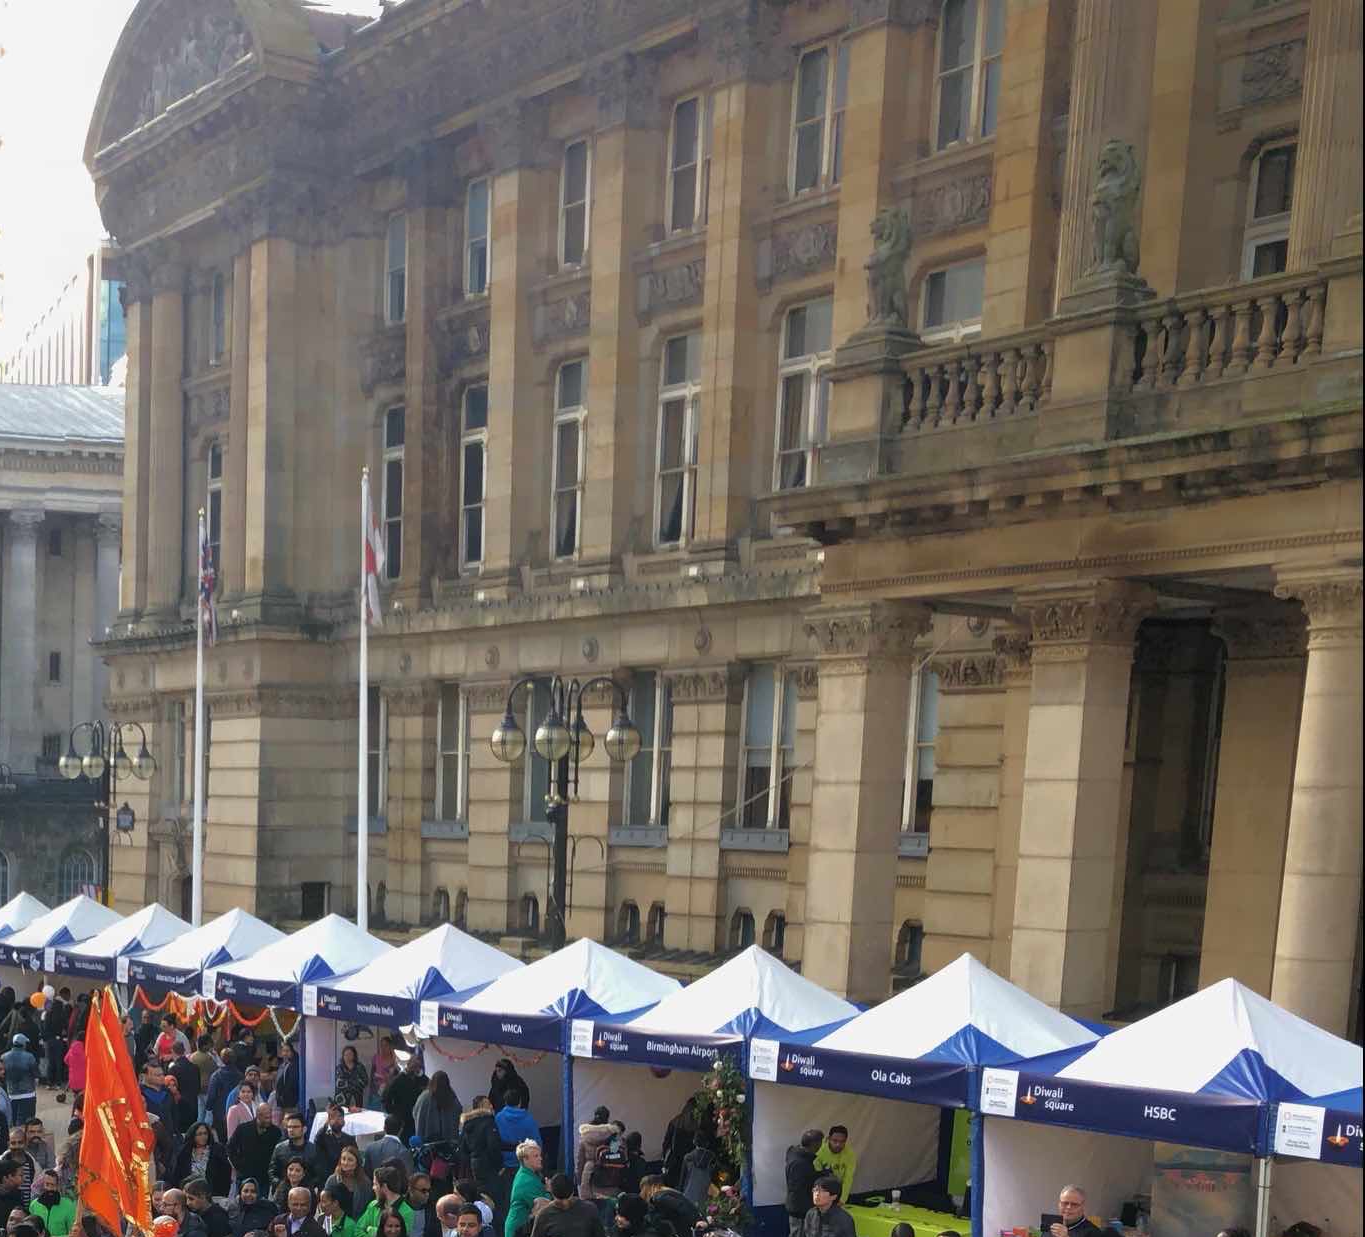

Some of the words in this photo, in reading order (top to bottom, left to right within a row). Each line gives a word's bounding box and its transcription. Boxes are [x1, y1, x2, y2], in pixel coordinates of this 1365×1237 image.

[381, 1006, 394, 1017] India
[501, 1023, 523, 1035] WMCA
[603, 1031, 622, 1042] Diwali
[609, 1042, 629, 1052] square
[646, 1041, 690, 1056] Birmingham
[691, 1047, 718, 1060] Airport
[791, 1053, 816, 1066] Diwali
[799, 1065, 825, 1078] square
[871, 1069, 887, 1082] Ola
[889, 1072, 912, 1086] Cabs
[1034, 1085, 1064, 1099] Diwali
[1044, 1099, 1075, 1113] square
[1143, 1105, 1178, 1121] HSBC
